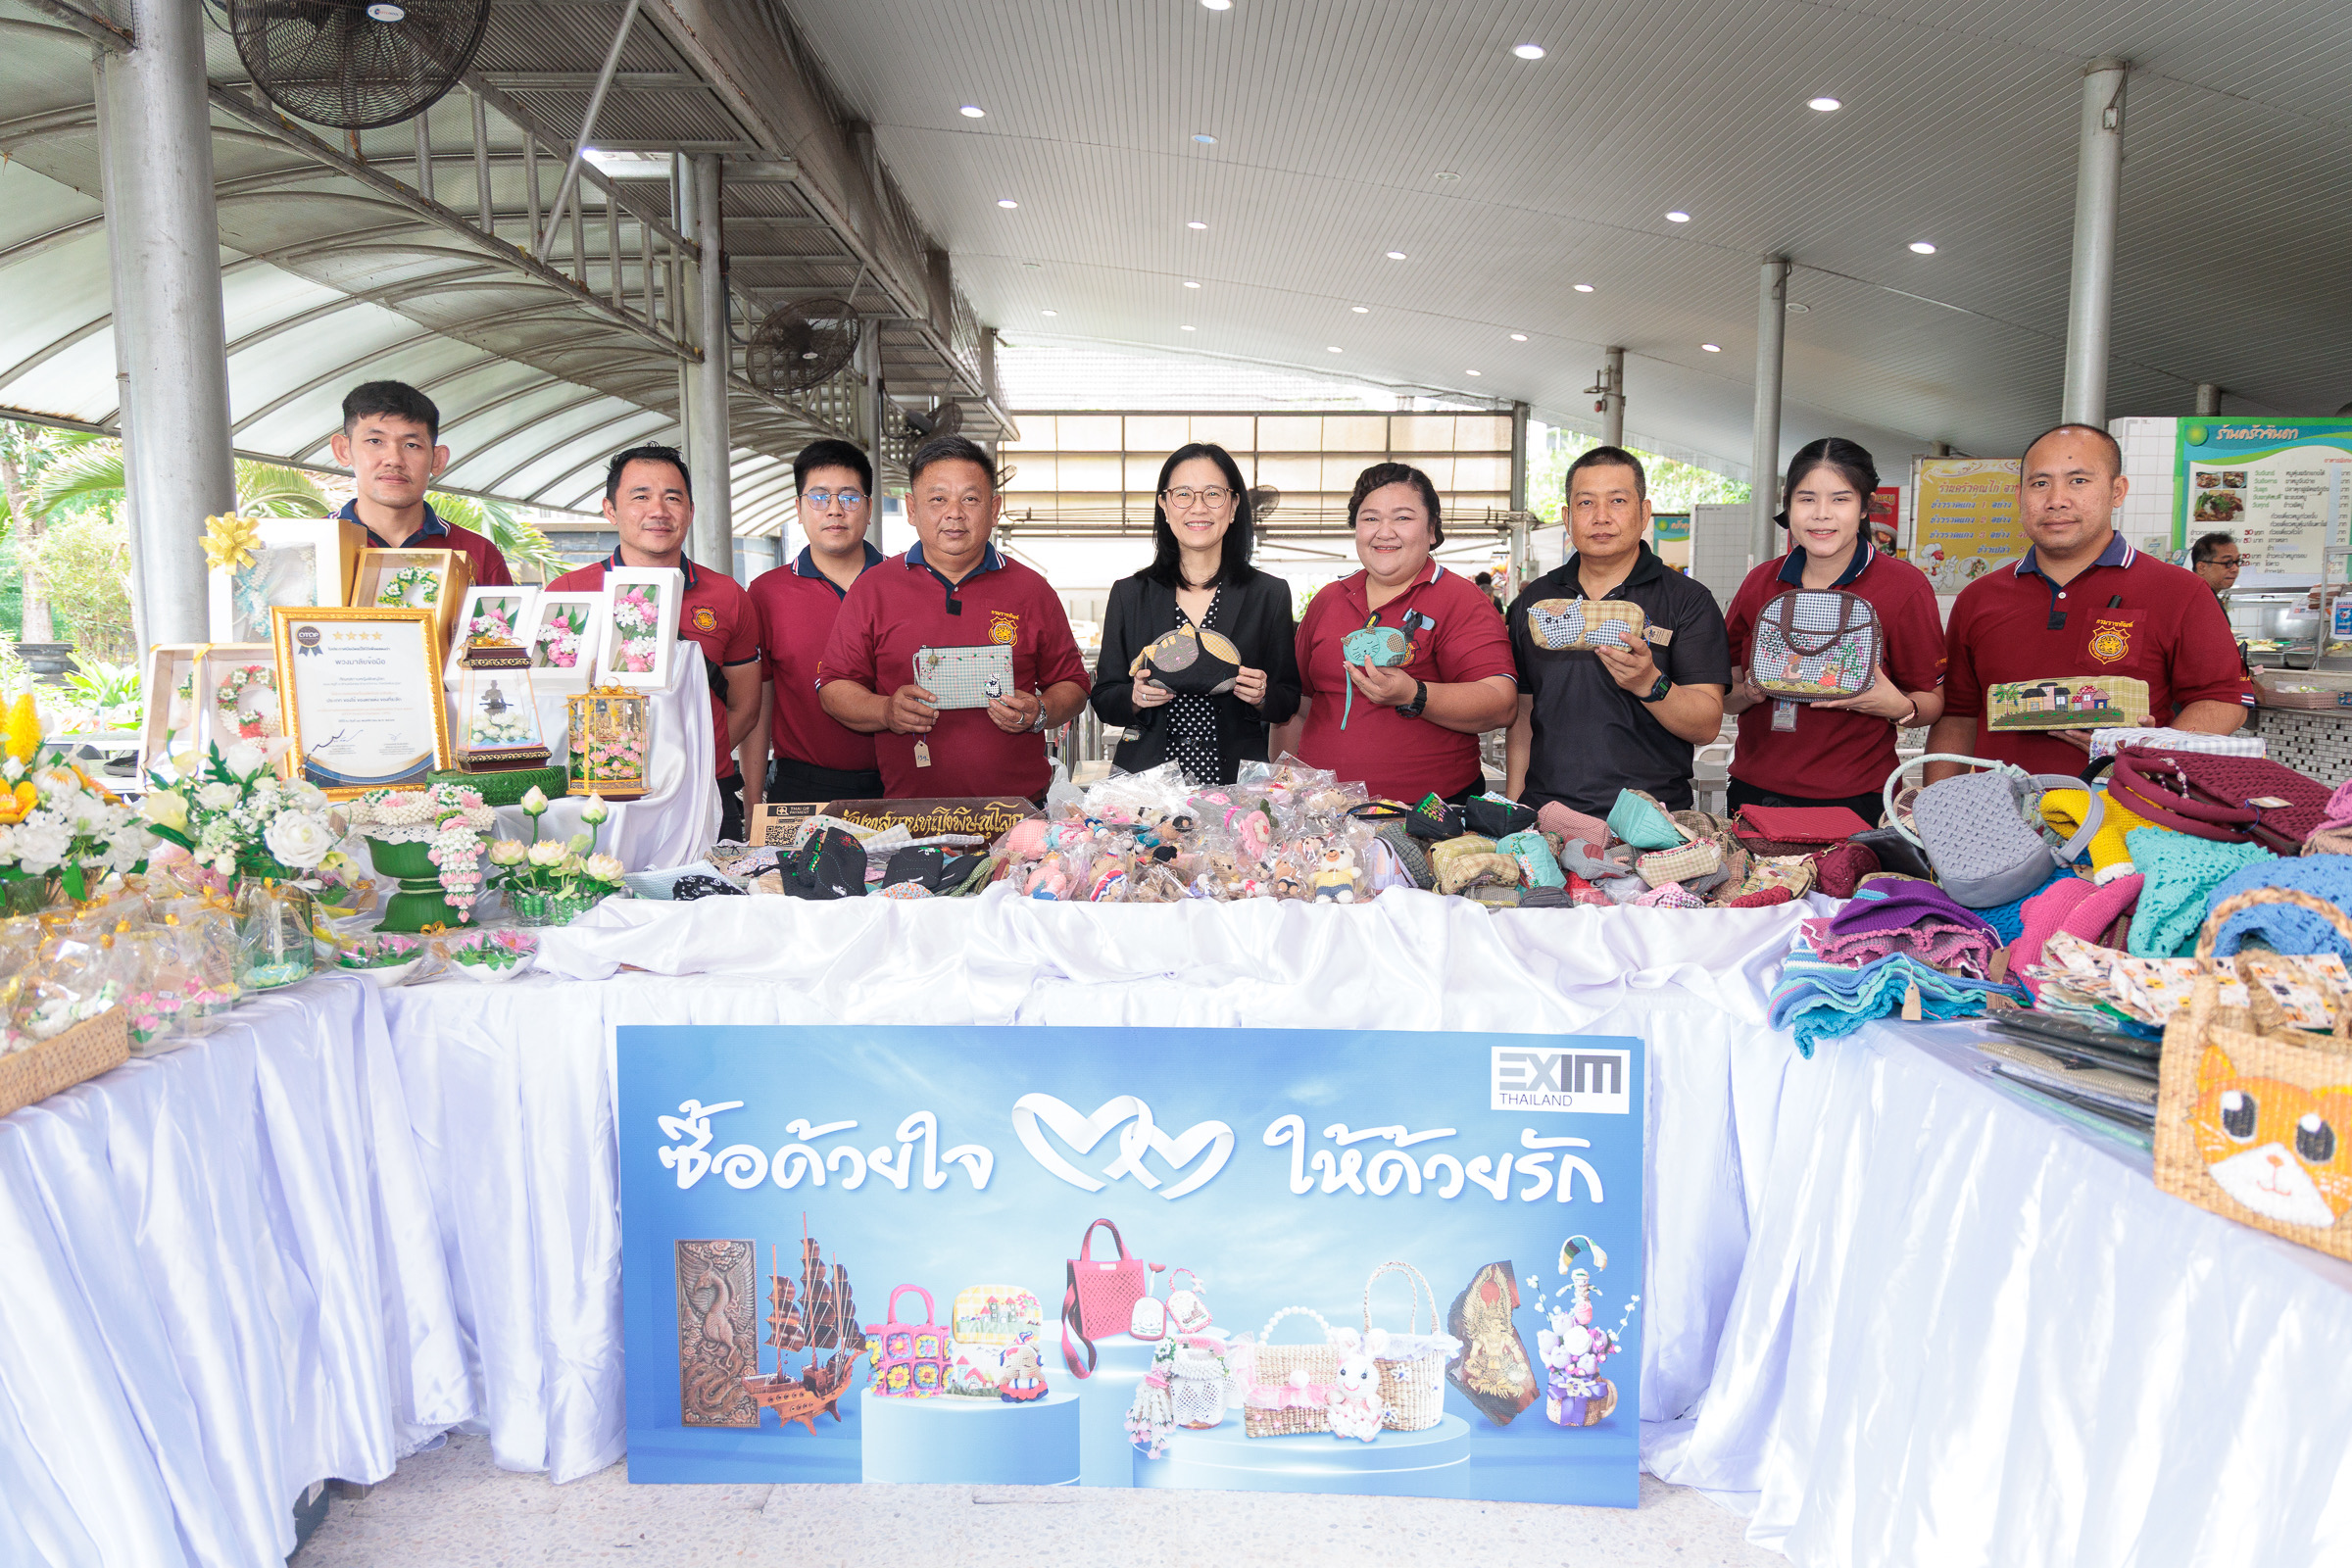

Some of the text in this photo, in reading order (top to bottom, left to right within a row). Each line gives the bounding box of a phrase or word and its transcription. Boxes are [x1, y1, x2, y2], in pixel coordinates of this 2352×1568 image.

[1938, 480, 2002, 498] ร้านครัวคุณไก่
[1931, 499, 1976, 509] ข้าวราดแกง
[1991, 499, 2012, 508] อย่าง
[1930, 514, 1976, 523] ข้าวราดแกง
[1991, 514, 2011, 523] อย่าง
[1929, 529, 1974, 539] ข้าวราดแกง
[1989, 529, 2011, 539] อย่าง
[1978, 544, 2011, 553] ข้าวเปล่า
[1499, 1053, 1622, 1094] EXIM
[1499, 1092, 1573, 1106] THAILAND
[657, 1099, 995, 1190] ซื้อด้วยใจ
[1262, 1113, 1605, 1203] ให้ด้วยรัก
